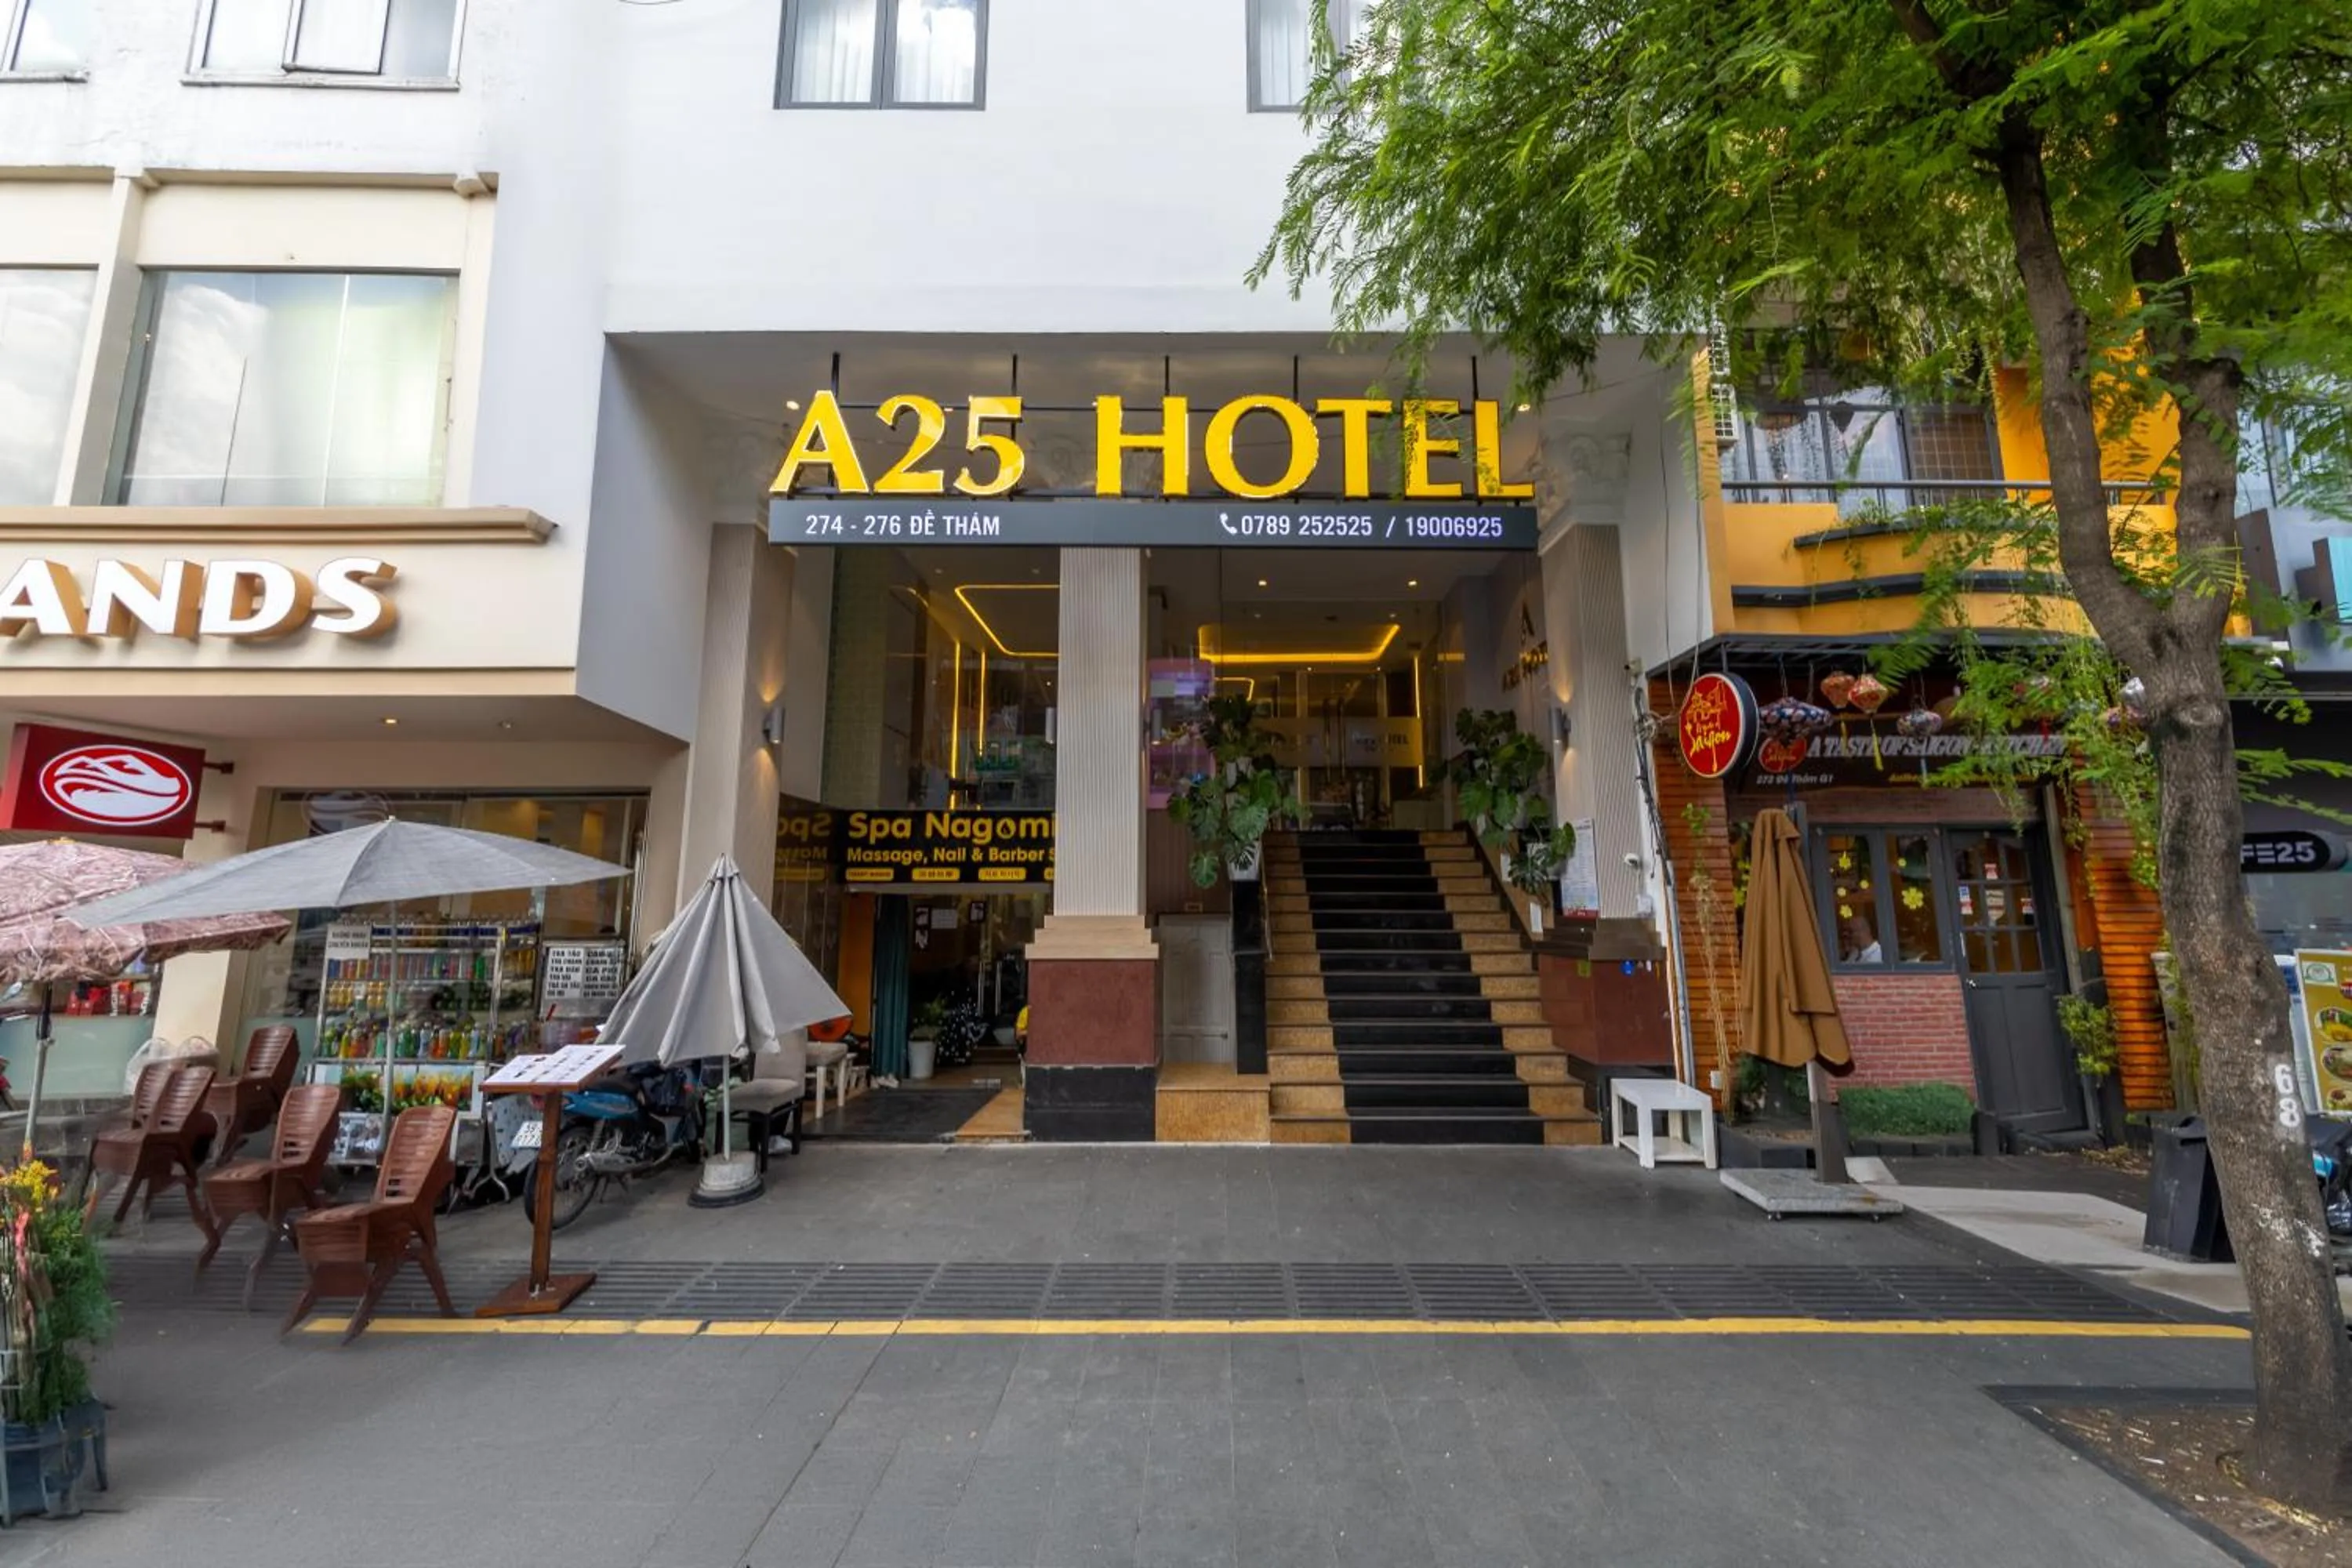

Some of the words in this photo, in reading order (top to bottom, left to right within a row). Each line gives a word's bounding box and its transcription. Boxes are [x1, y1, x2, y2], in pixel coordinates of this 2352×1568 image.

[769, 390, 1025, 496] A25
[1096, 394, 1536, 499] HOTEL
[805, 514, 844, 535] 274
[863, 514, 901, 535] 276
[1241, 515, 1290, 535] 0789
[1298, 515, 1372, 535] 252525
[1406, 516, 1502, 537] 19006925
[0, 557, 397, 637] ANDS
[1806, 735, 1822, 758] A
[848, 812, 912, 844] Spa
[847, 847, 928, 866] Massage,
[933, 847, 966, 862] Nail
[972, 848, 983, 862] &
[989, 847, 1044, 862] Barber
